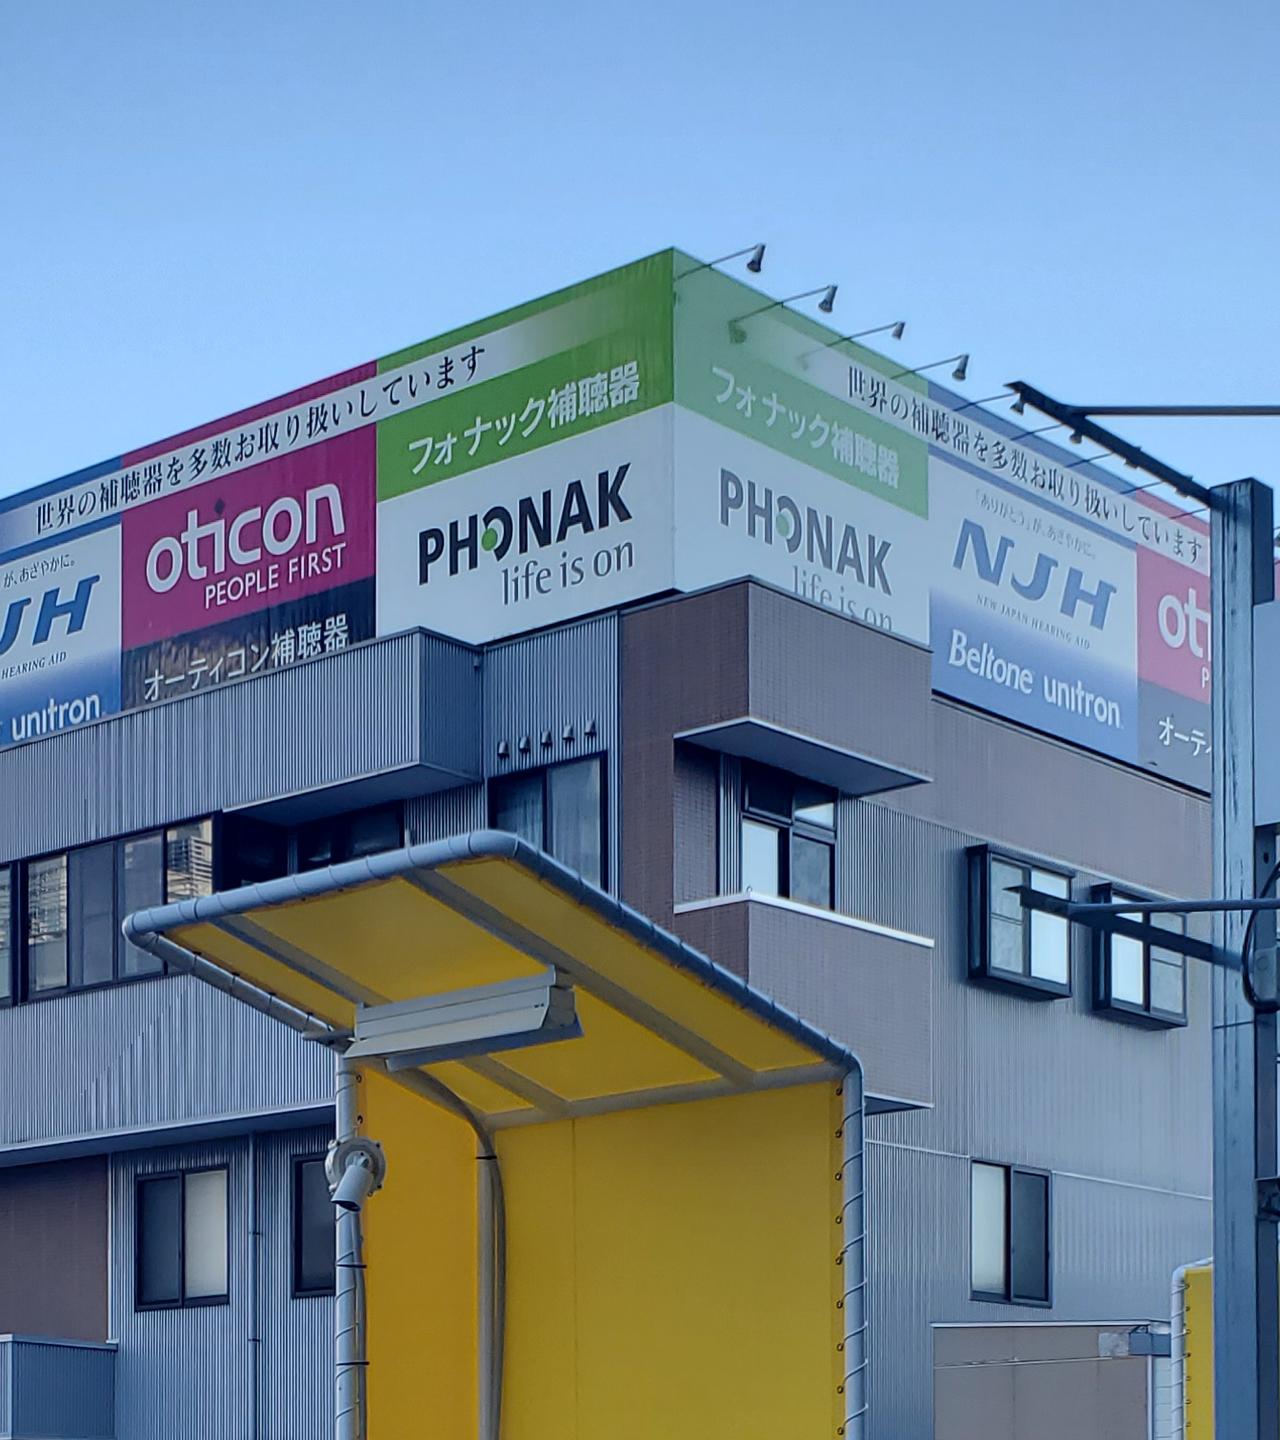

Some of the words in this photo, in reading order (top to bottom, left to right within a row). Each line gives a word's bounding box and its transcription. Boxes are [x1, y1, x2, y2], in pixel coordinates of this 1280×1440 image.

[35, 345, 486, 535] 世界の補聴器を多数お取り扱いしています
[408, 361, 640, 475] フォナック補聴器
[712, 363, 900, 490] フォナック補聴器
[847, 365, 1203, 565] 世界の補聴器を多数お取り扱いしています
[145, 483, 346, 594] oticon
[205, 569, 280, 609] PEOPLE
[287, 543, 347, 584] FIRST
[419, 463, 634, 586] PHONAK
[502, 557, 553, 606] life
[559, 550, 586, 588] is
[593, 540, 635, 577] on
[720, 468, 893, 597] PHONAK
[952, 518, 1118, 631] NJH
[792, 564, 833, 608] life
[839, 587, 859, 620] is
[1, 658, 46, 680] HEARING
[48, 651, 67, 667] AID
[142, 614, 350, 703] オーティコン補聴器
[948, 629, 1034, 694] Beltone
[1043, 675, 1122, 730] unitron
[12, 694, 100, 742] unitron
